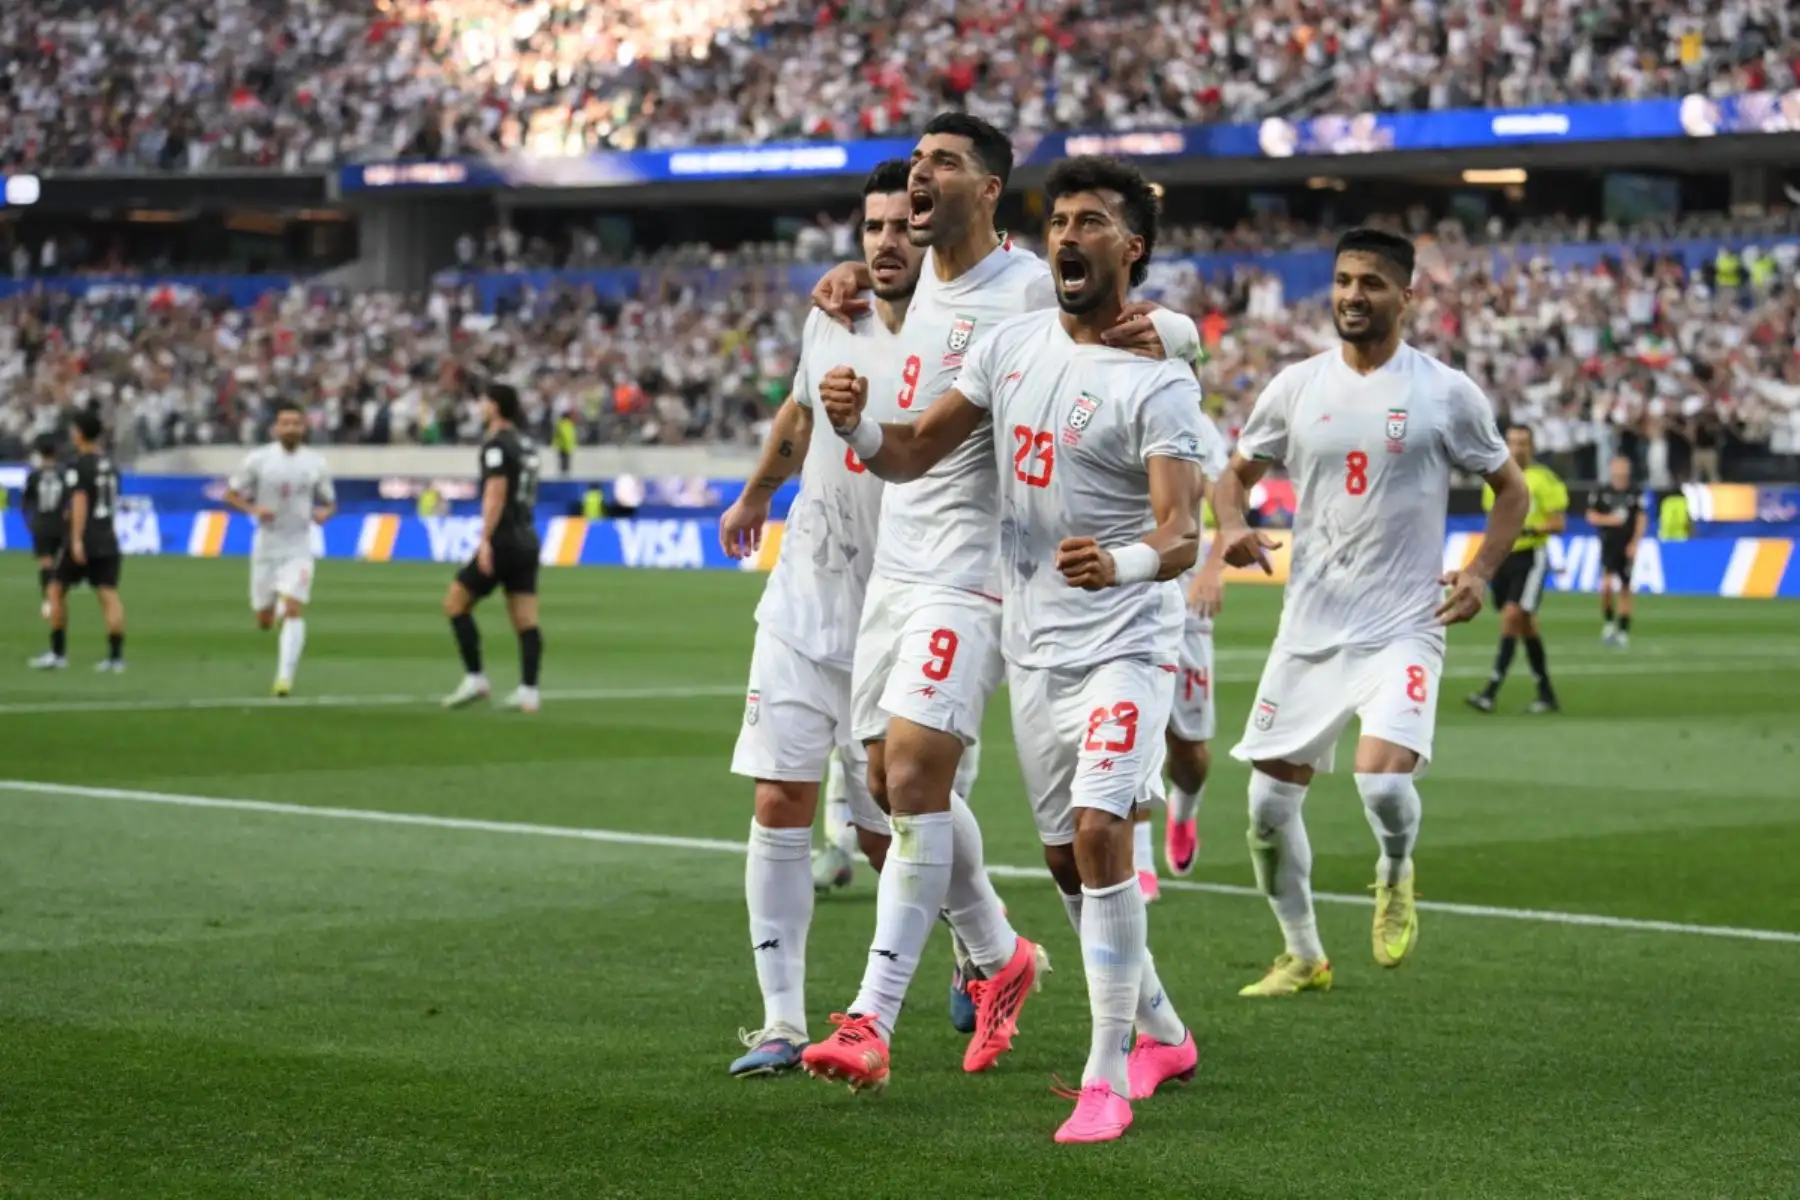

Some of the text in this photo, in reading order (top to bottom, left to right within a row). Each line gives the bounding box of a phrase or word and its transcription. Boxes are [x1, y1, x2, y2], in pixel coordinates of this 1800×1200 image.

[898, 354, 921, 409] 9
[1014, 424, 1054, 488] 23
[1346, 450, 1368, 496] 8
[427, 515, 484, 562] VIS
[615, 519, 704, 567] VISA
[1546, 534, 1665, 593] VIA
[922, 628, 959, 681] 9
[1184, 667, 1208, 701] 14
[1406, 664, 1428, 703] 8
[1085, 701, 1139, 753] 23
